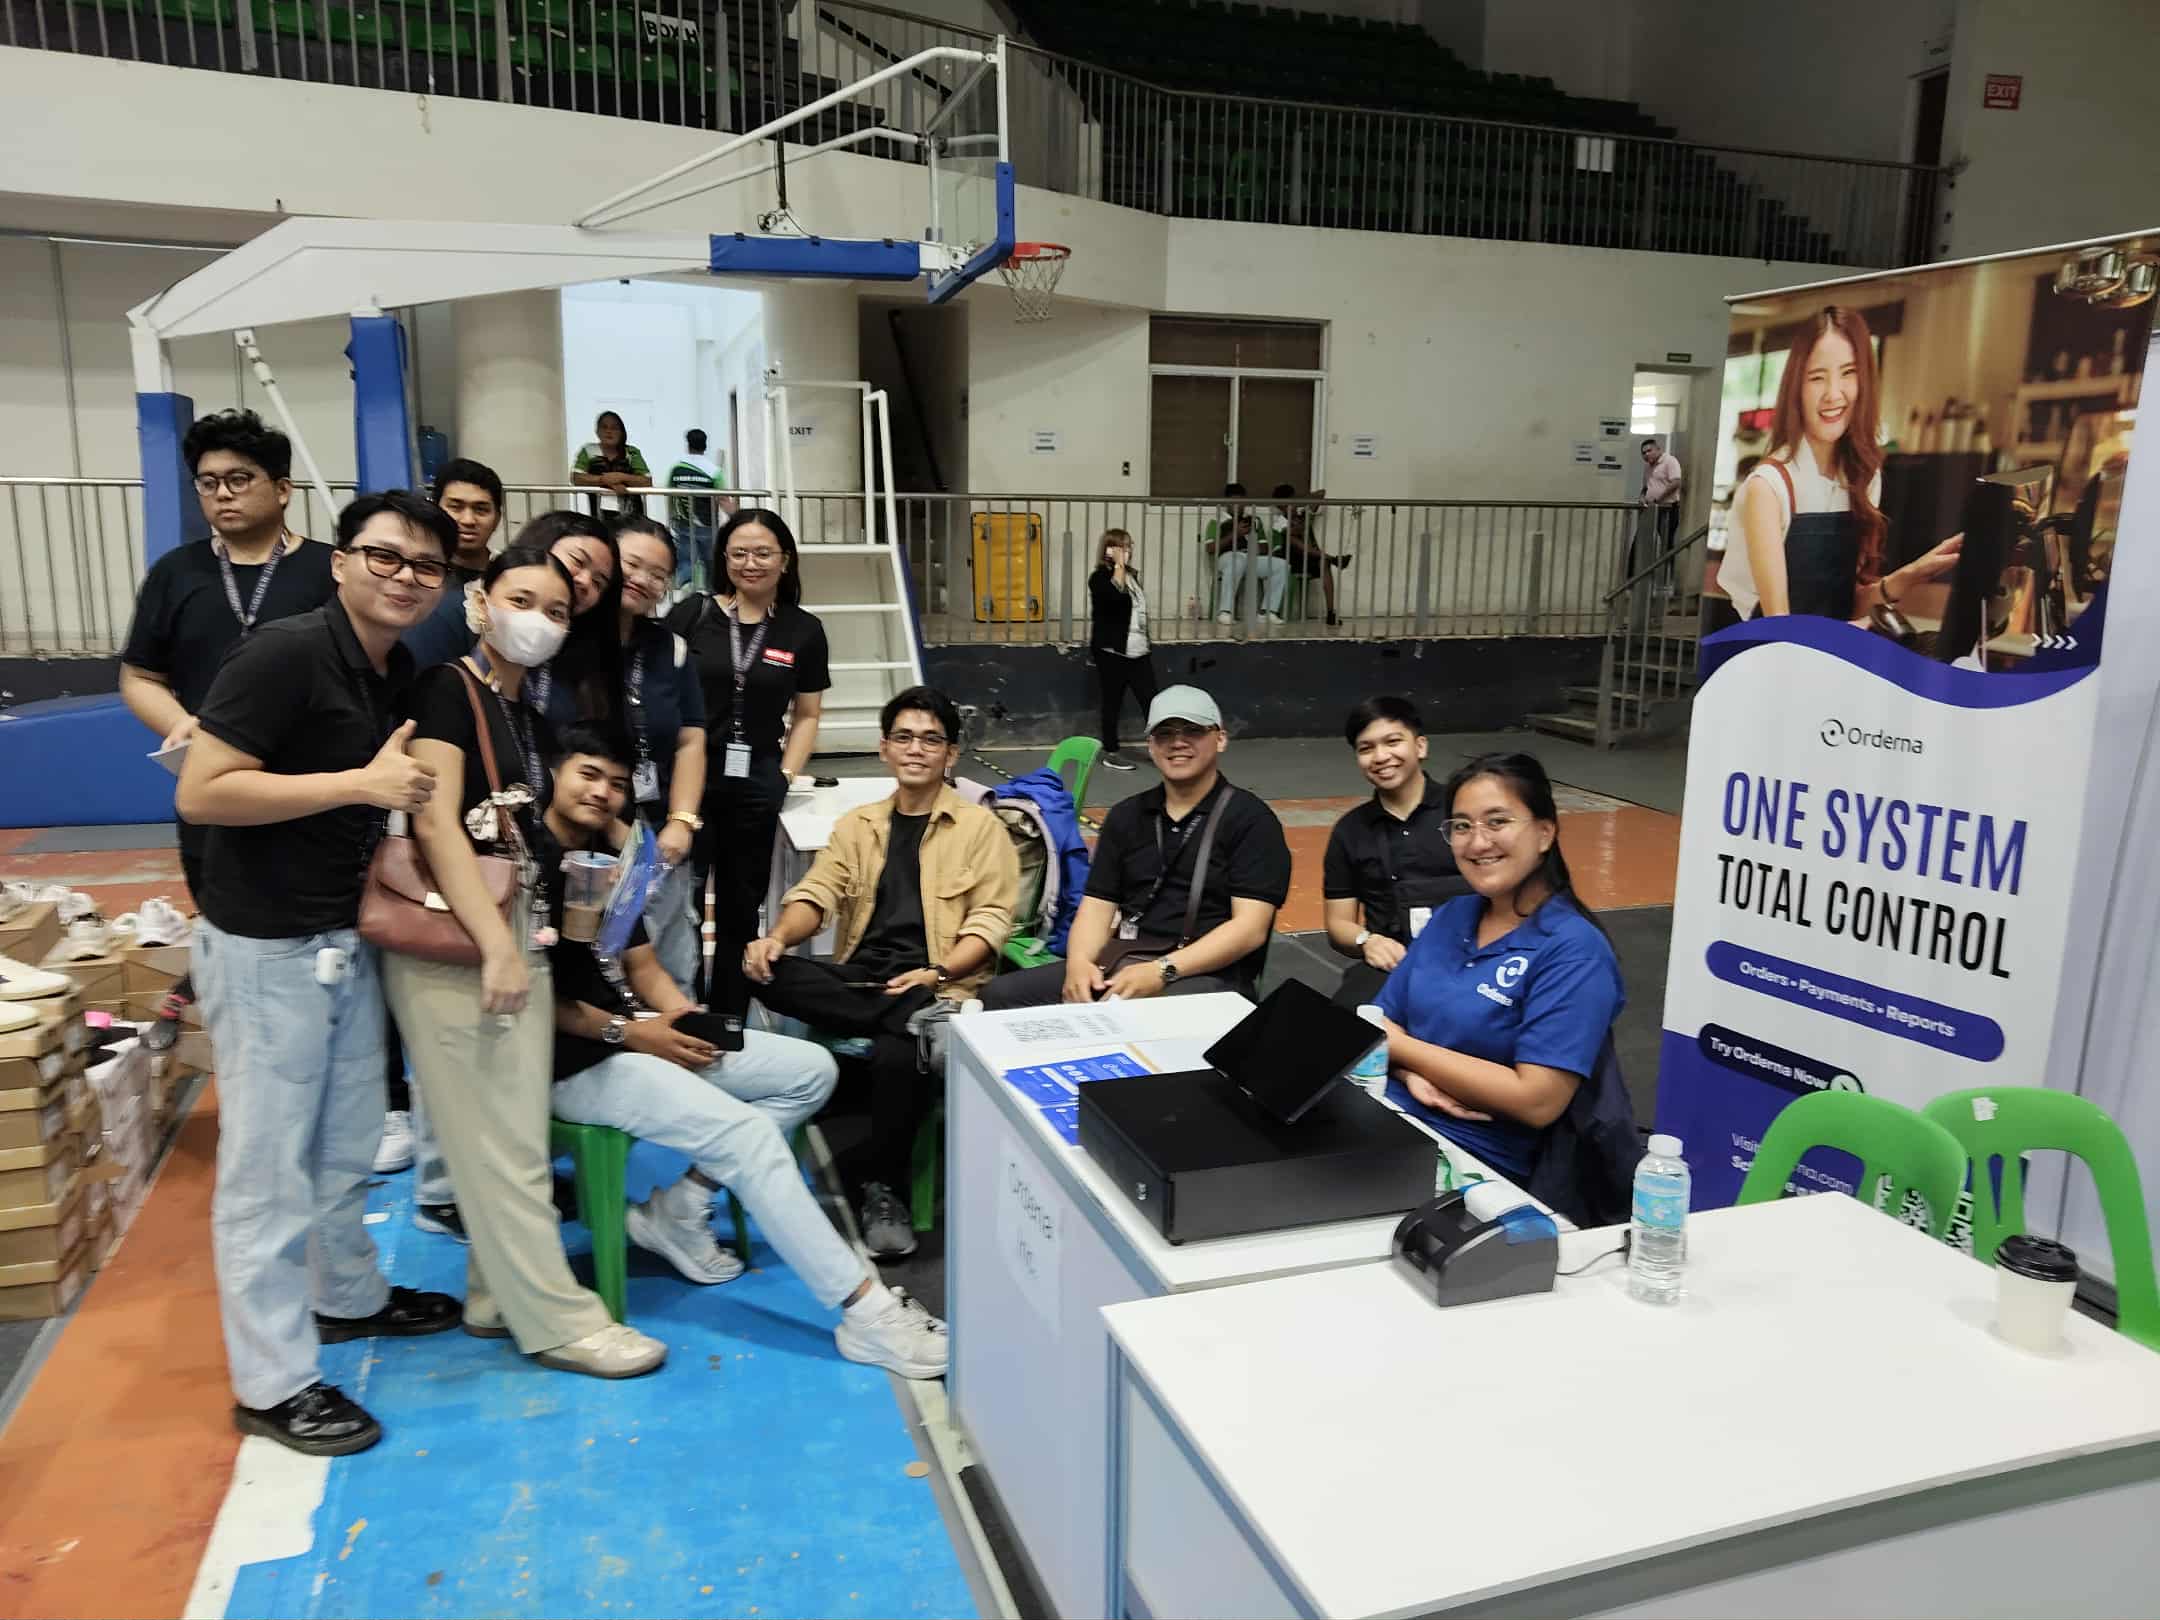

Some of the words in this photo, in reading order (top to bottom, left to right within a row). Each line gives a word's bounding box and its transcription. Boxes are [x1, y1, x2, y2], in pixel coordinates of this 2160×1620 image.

[645, 20, 679, 39] BOX
[1848, 727, 1922, 754] Orderna
[1723, 771, 1809, 850] ONE
[1821, 788, 2028, 896] SYSTEM
[1717, 853, 1812, 928] TOTAL
[1825, 880, 2011, 979] CONTROL
[1739, 961, 1790, 987] Orders
[1799, 978, 1876, 1014] Payments
[1885, 1005, 1956, 1037] Reports
[1710, 1036, 1734, 1057] Try
[1733, 1046, 1792, 1077] Orderna
[1793, 1067, 1830, 1090] Now
